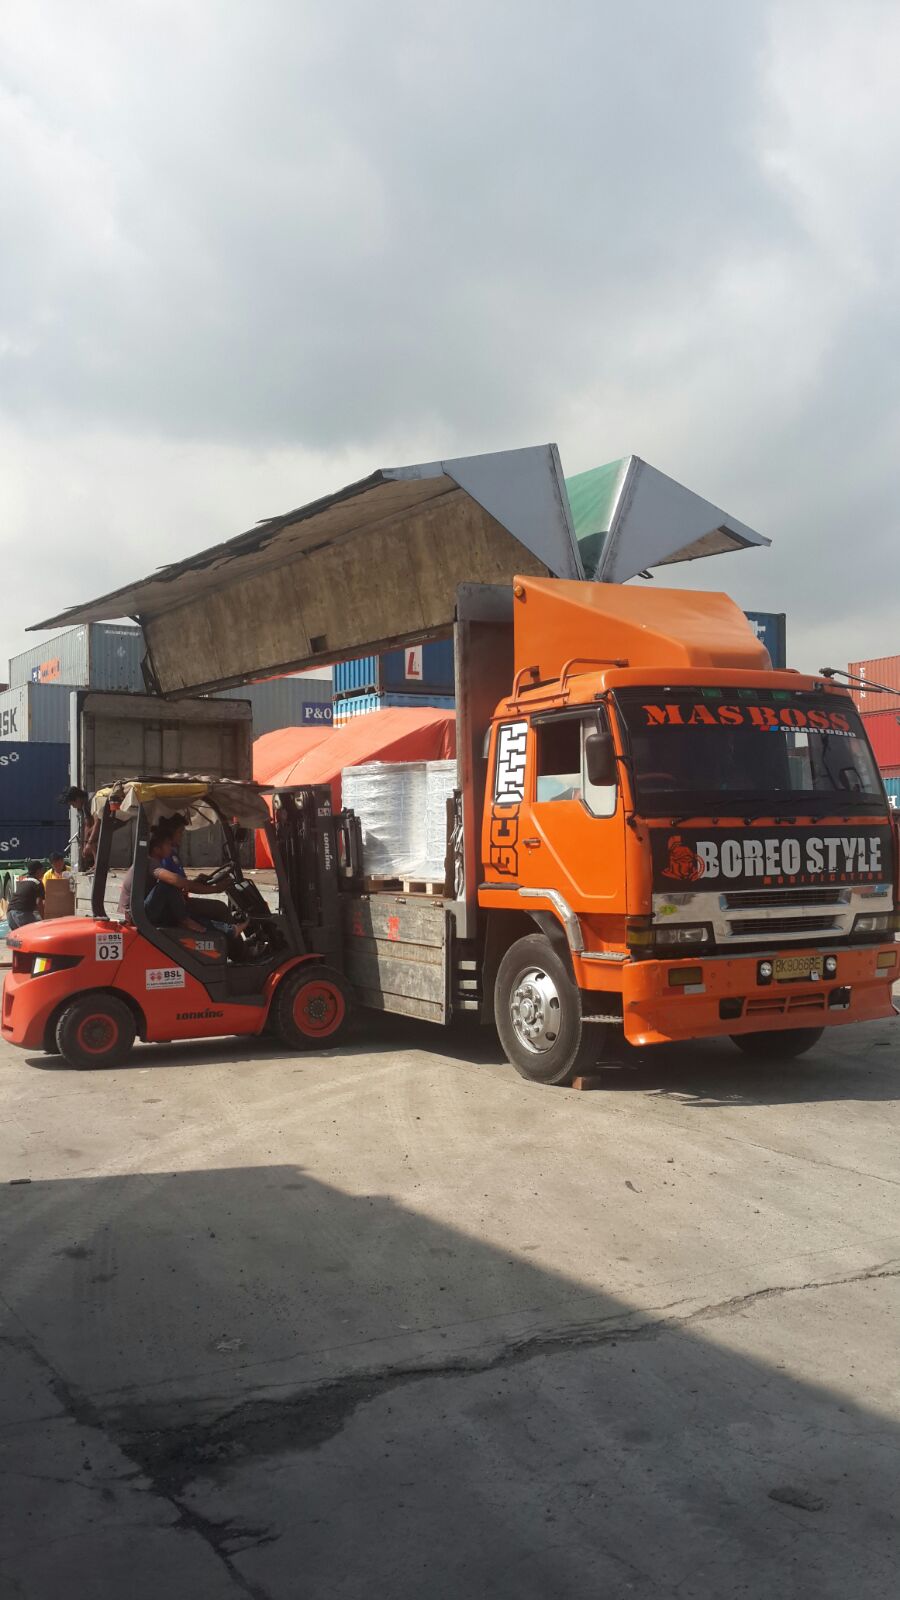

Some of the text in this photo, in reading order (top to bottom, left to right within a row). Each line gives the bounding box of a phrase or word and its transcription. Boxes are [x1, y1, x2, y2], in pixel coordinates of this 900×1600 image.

[305, 707, 332, 719] P&O
[641, 704, 850, 731] MAS BOSS
[696, 837, 882, 879] BOREO STYLE
[98, 945, 120, 960] 03
[163, 970, 182, 978] BSL
